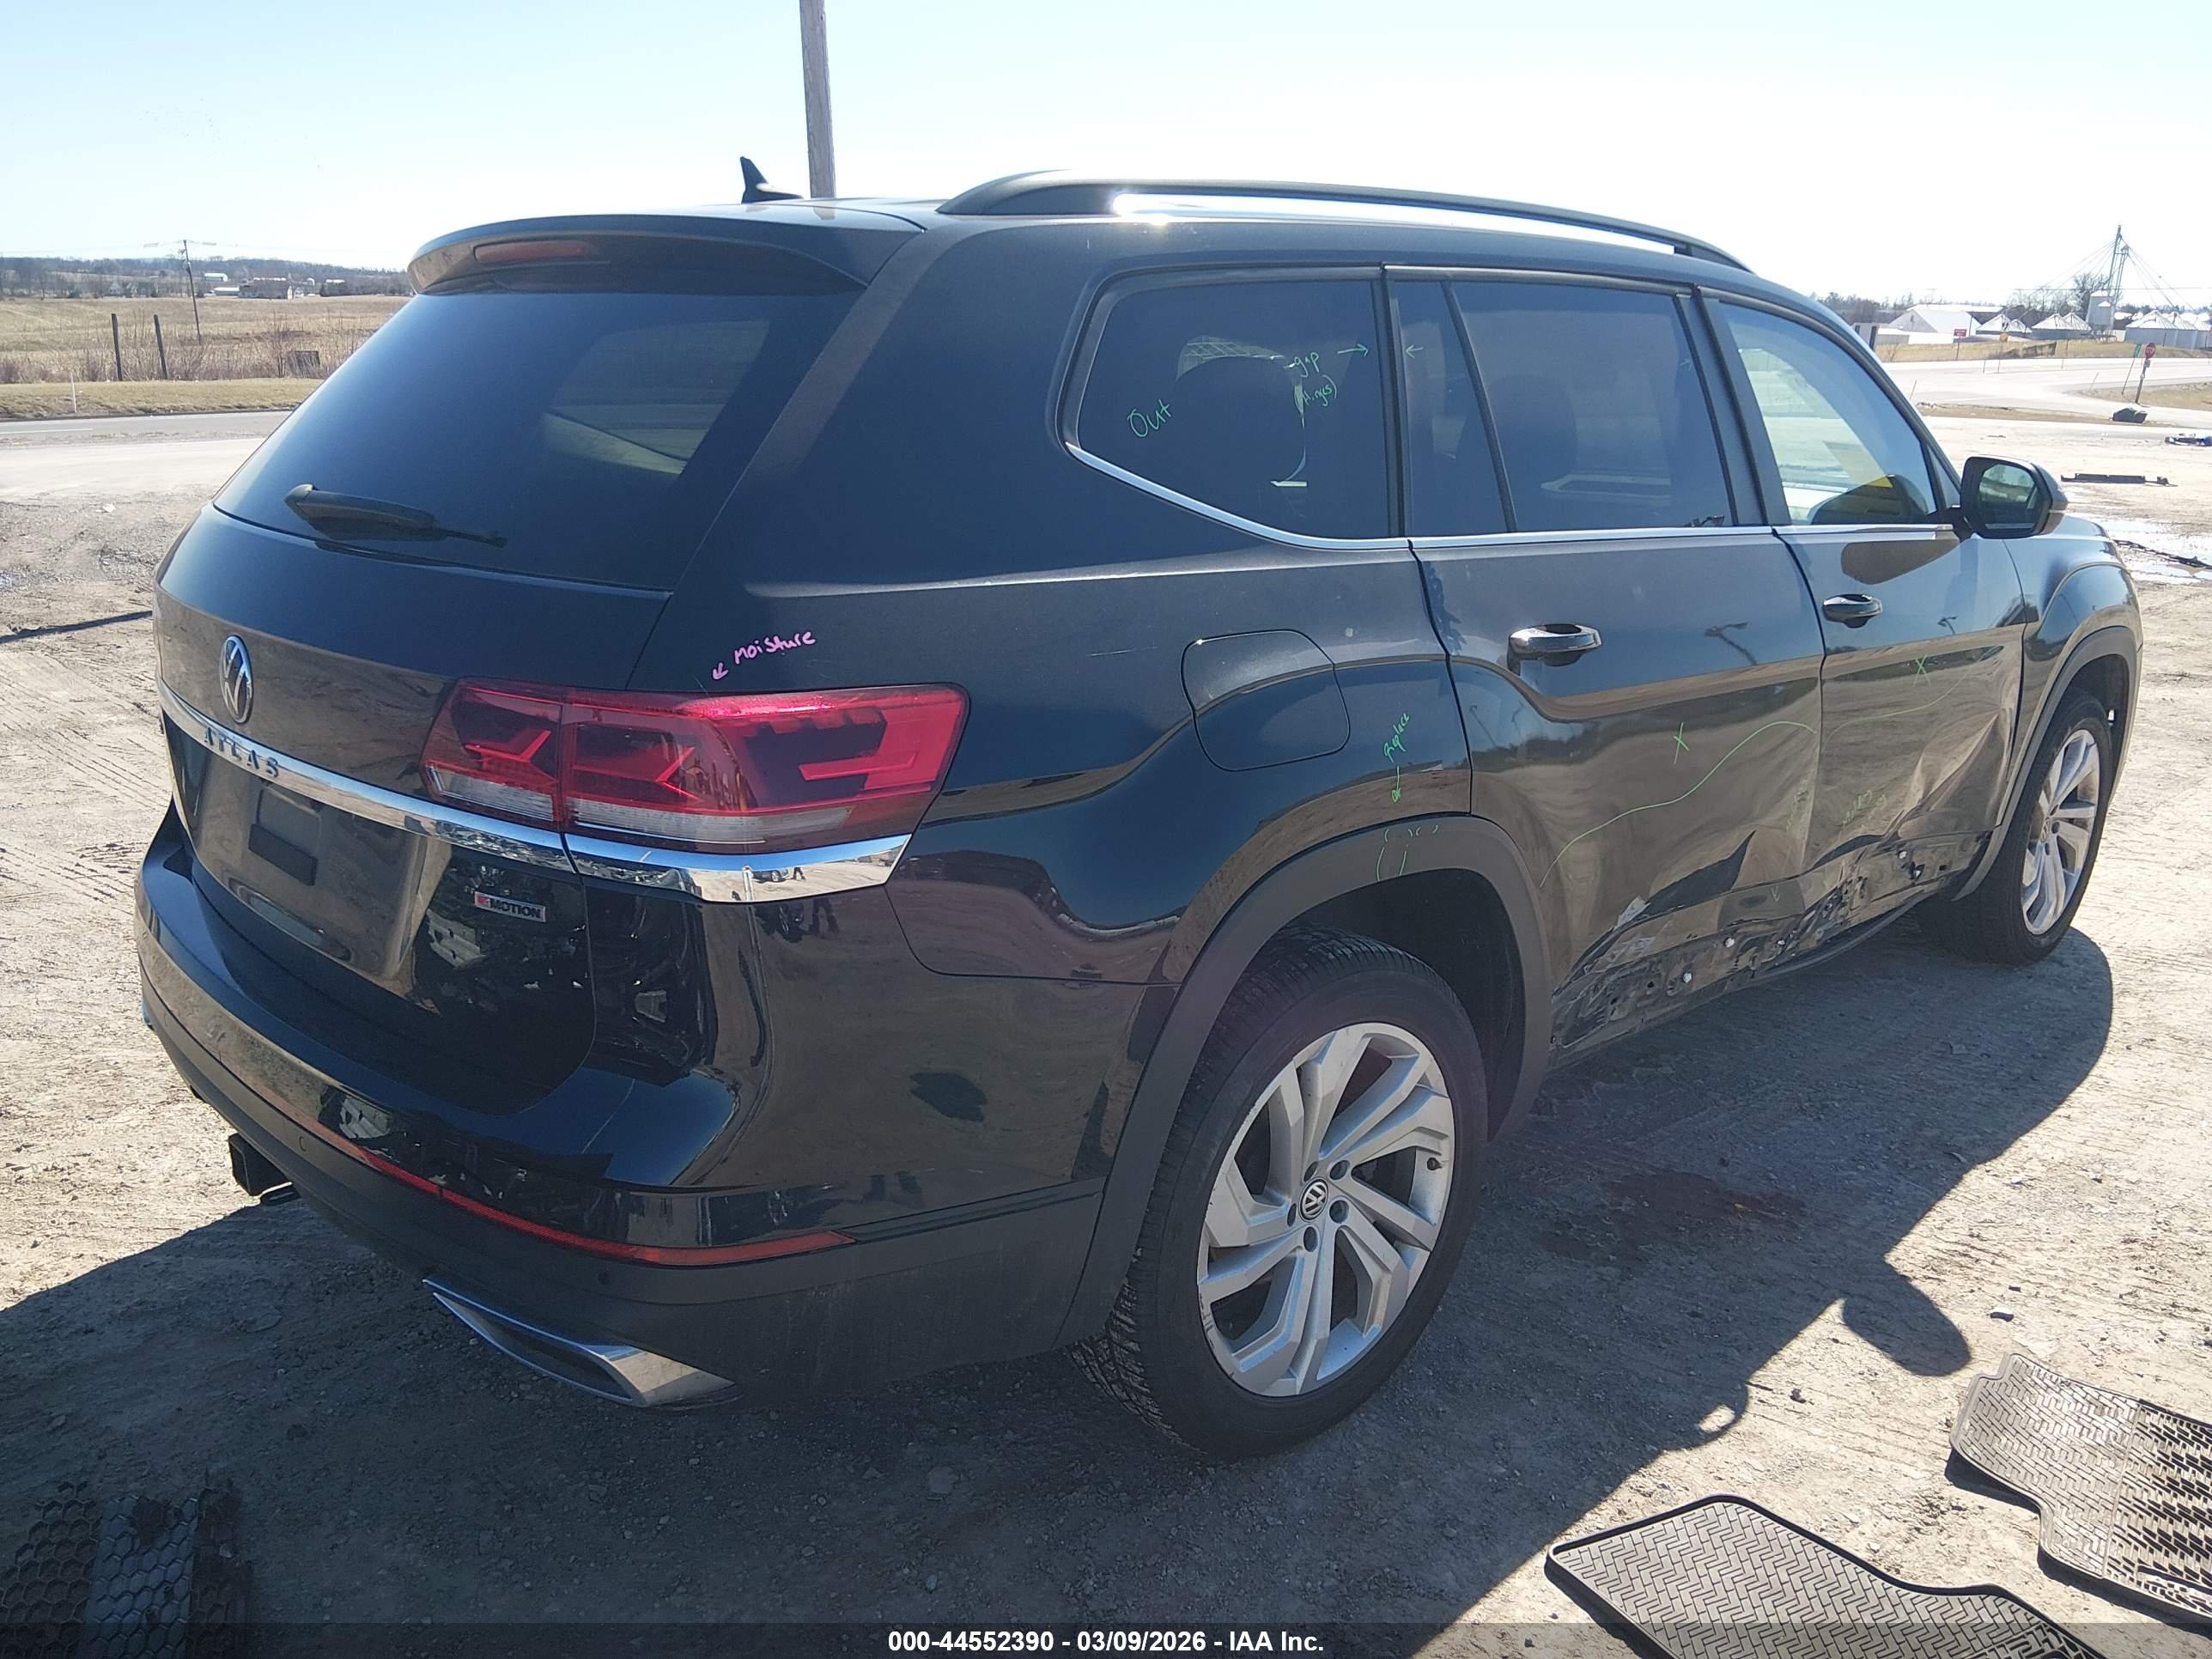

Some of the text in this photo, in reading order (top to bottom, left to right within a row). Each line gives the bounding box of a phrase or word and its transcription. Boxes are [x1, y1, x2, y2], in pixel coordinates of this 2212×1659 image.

[1294, 351, 1320, 378] gap
[1127, 399, 1173, 438] Out
[204, 726, 279, 778] ATLAS
